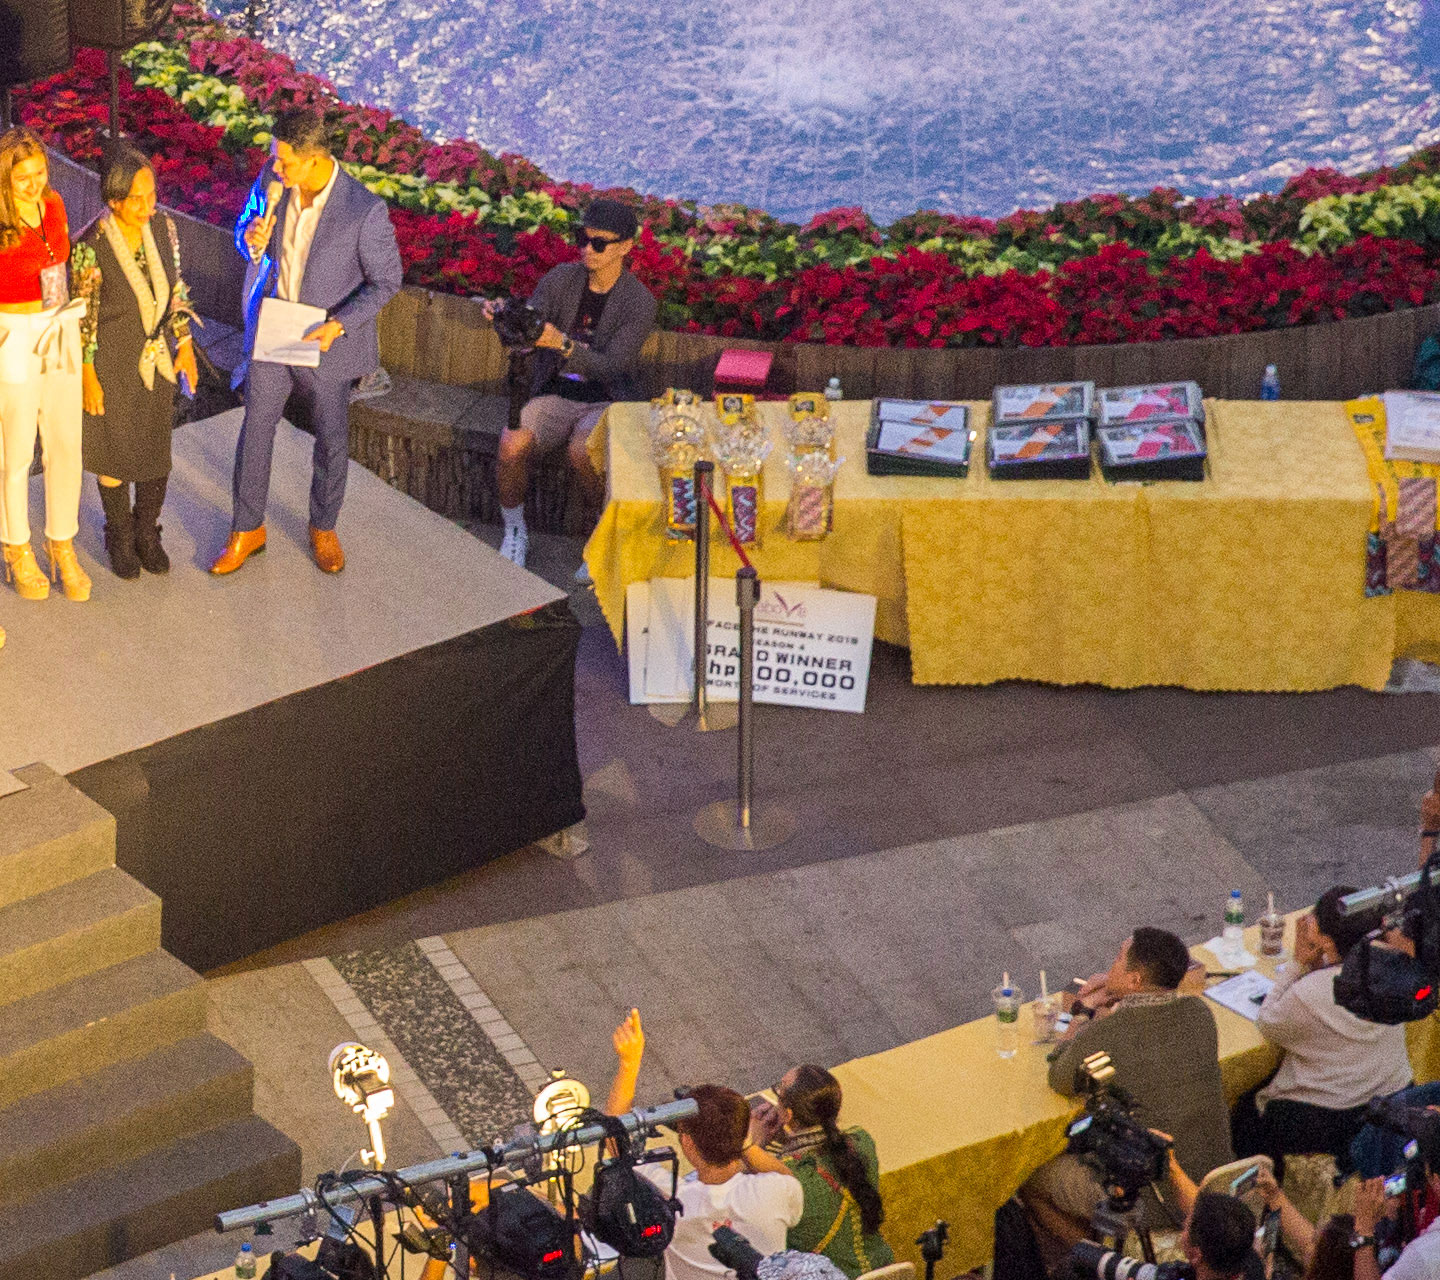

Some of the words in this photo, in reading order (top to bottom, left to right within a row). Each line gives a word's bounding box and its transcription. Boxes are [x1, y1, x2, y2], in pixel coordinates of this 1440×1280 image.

[772, 628, 822, 640] RUNWAY
[755, 638, 793, 650] EASON
[775, 653, 852, 671] WINNER
[772, 686, 836, 700] SERVICES
